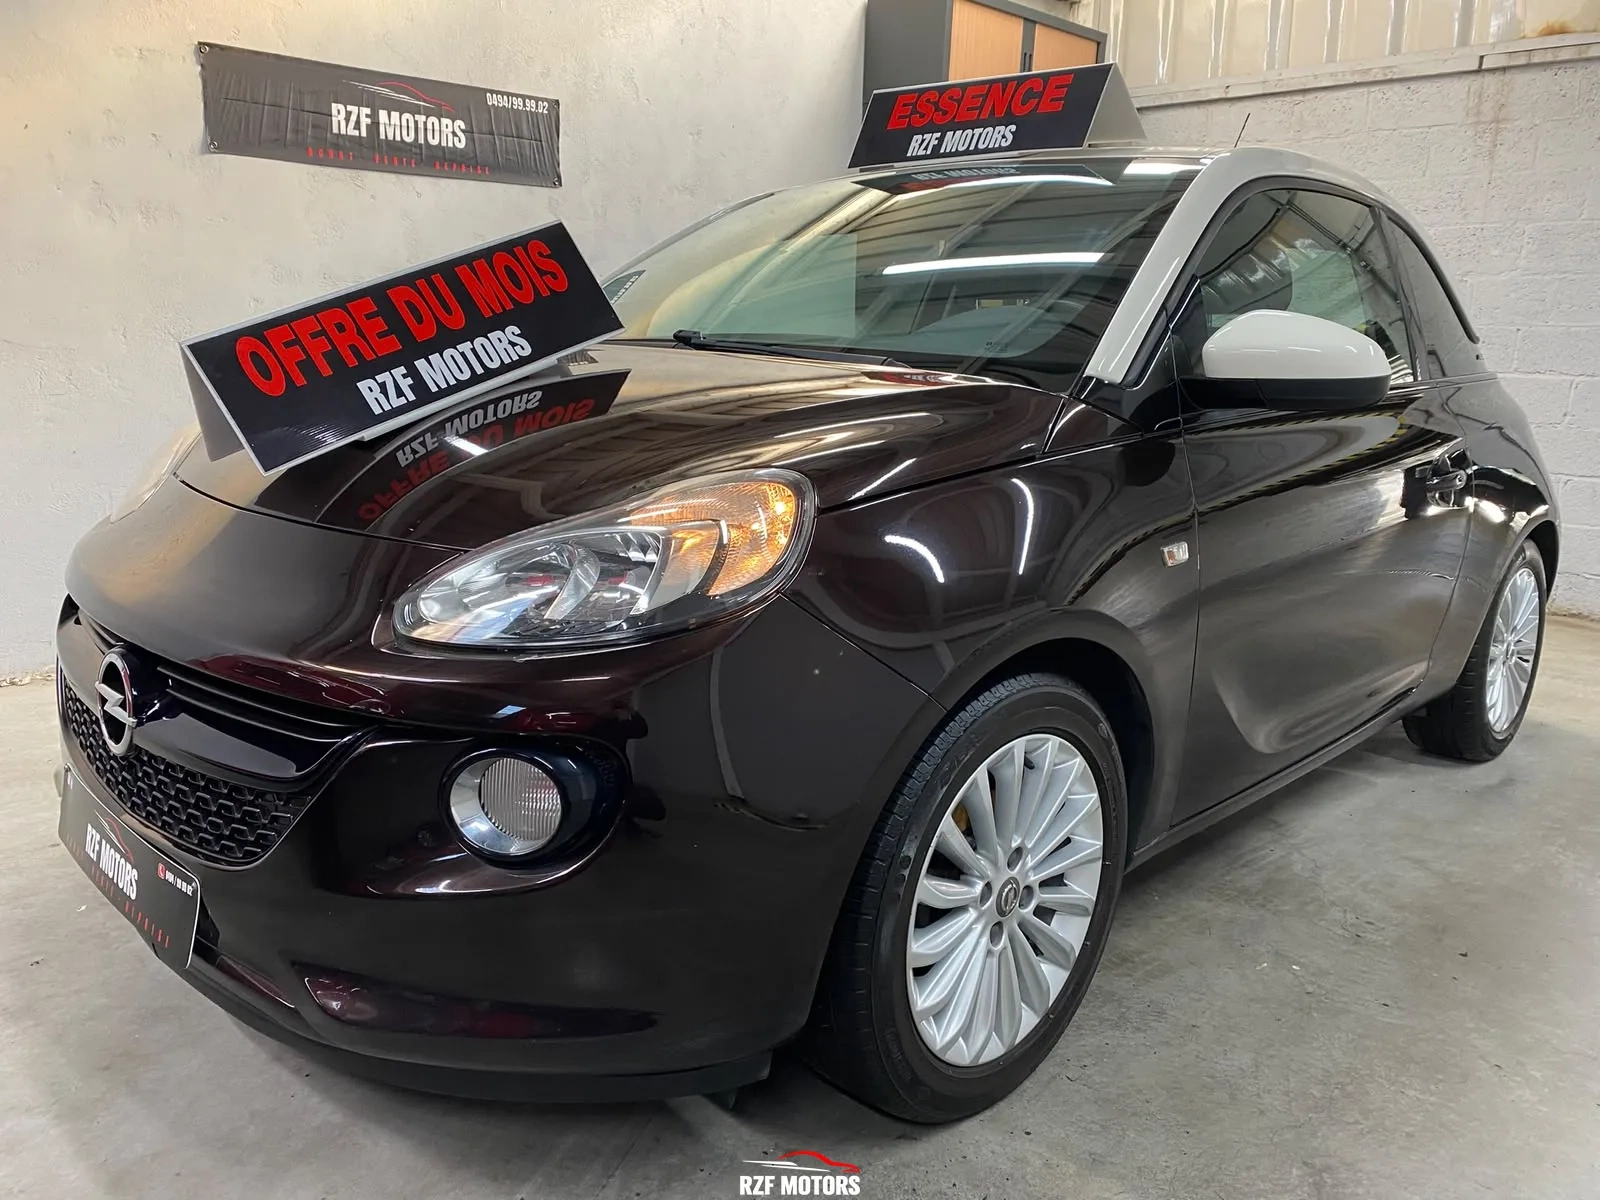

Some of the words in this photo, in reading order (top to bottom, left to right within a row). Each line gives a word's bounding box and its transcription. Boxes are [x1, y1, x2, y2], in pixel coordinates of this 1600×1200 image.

[331, 102, 371, 138] RZF
[378, 109, 466, 149] MOTORS
[486, 92, 549, 114] 0494/99.99.02
[886, 73, 1075, 130] ESSENCE
[907, 131, 941, 157] RZF
[939, 124, 1017, 153] MOTORS
[235, 296, 402, 397] OFFRE
[386, 272, 466, 342] DU
[454, 239, 569, 319] MOIS
[356, 365, 416, 416] RZF
[413, 325, 533, 393] MOTORS
[85, 823, 100, 862] RZF
[99, 838, 138, 901] MOTORS
